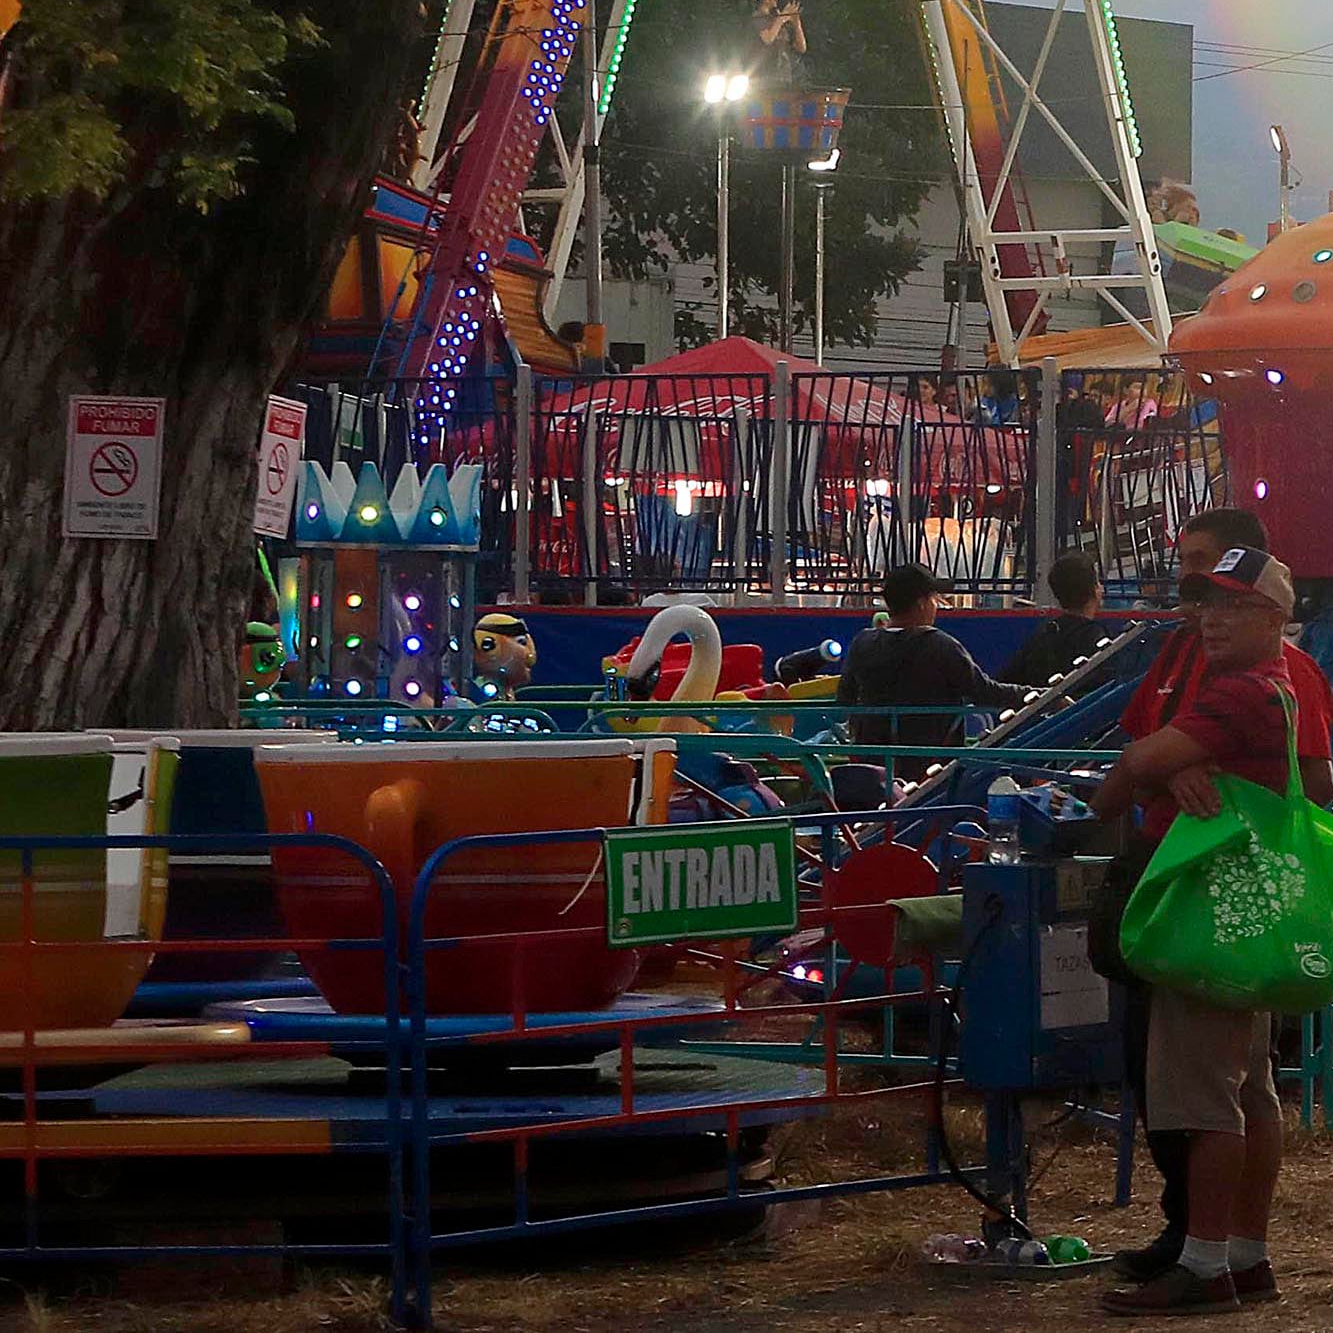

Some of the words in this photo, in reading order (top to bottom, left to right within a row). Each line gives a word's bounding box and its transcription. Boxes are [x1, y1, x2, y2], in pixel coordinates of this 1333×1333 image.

[80, 406, 156, 420] PROHIBIDO
[92, 420, 140, 432] FUMAR
[622, 842, 782, 914] ENTRADA
